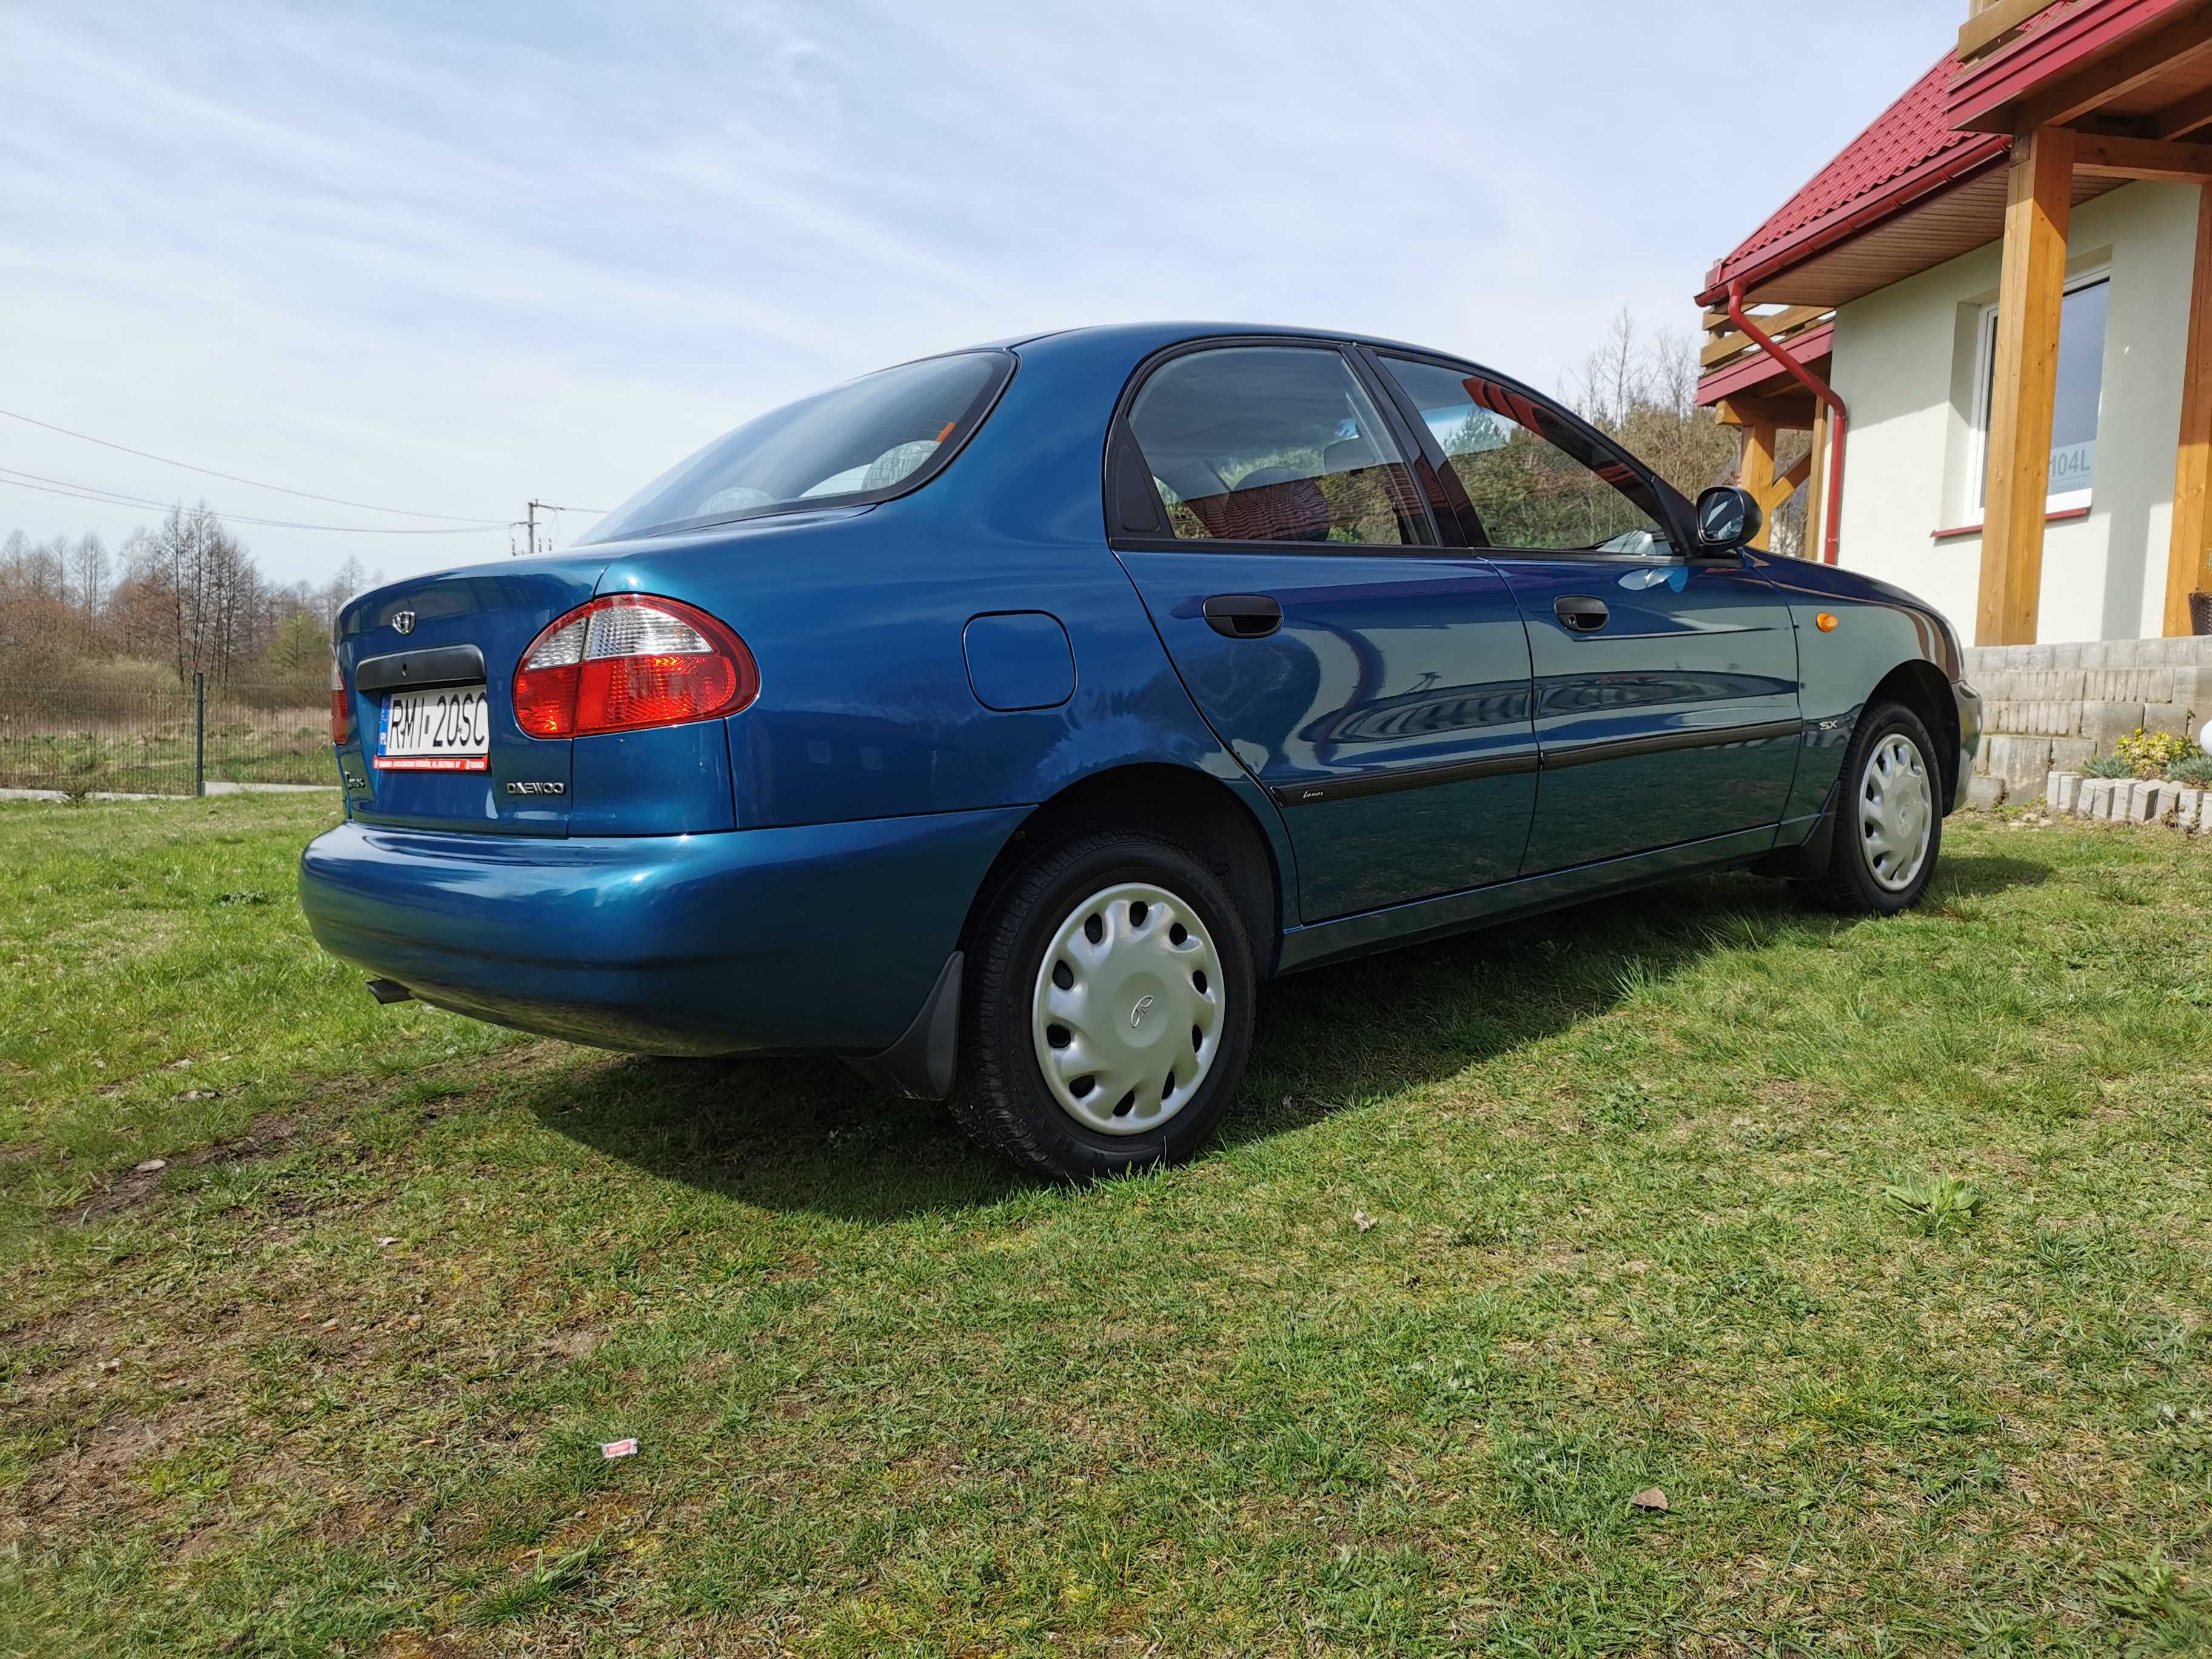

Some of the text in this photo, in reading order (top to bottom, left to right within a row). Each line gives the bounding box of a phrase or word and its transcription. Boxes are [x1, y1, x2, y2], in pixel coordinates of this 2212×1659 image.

[389, 692, 488, 749] RMI 20SC
[1819, 720, 1837, 730] SX
[506, 782, 565, 795] DAEWOO
